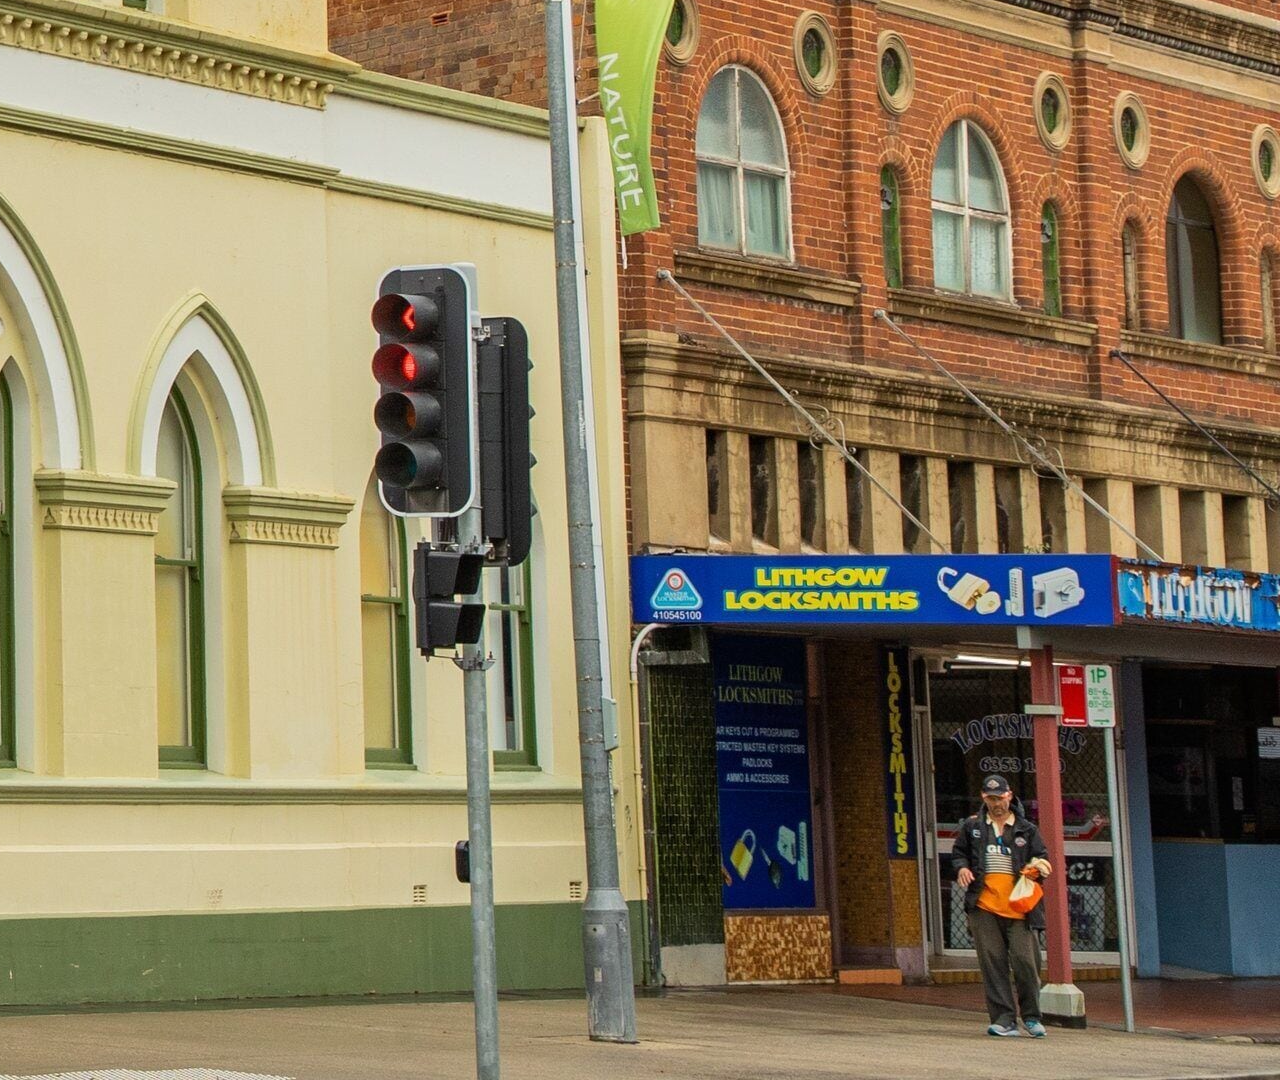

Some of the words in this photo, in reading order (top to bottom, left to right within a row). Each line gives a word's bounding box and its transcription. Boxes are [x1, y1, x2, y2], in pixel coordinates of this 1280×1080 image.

[598, 52, 644, 211] NATURE
[755, 567, 889, 587] LITHGOW
[724, 590, 919, 611] LOCKSMITHS
[652, 610, 702, 620] 410545100
[728, 664, 783, 682] LITHGOW
[1090, 667, 1107, 683] 1P
[718, 685, 793, 705] LOCKSMITHS
[726, 726, 740, 736] KEYS
[742, 727, 753, 736] CUT
[760, 728, 800, 738] PROGRAMMED
[950, 713, 1087, 754] LOCKSMHS
[768, 743, 779, 753] KEY
[780, 744, 806, 754] SYSTEMS
[887, 652, 908, 854] LOCKSMITHS
[742, 758, 773, 768] PADLOCKS
[979, 757, 1022, 772] 6353
[750, 774, 789, 784] ACCESSORIES
